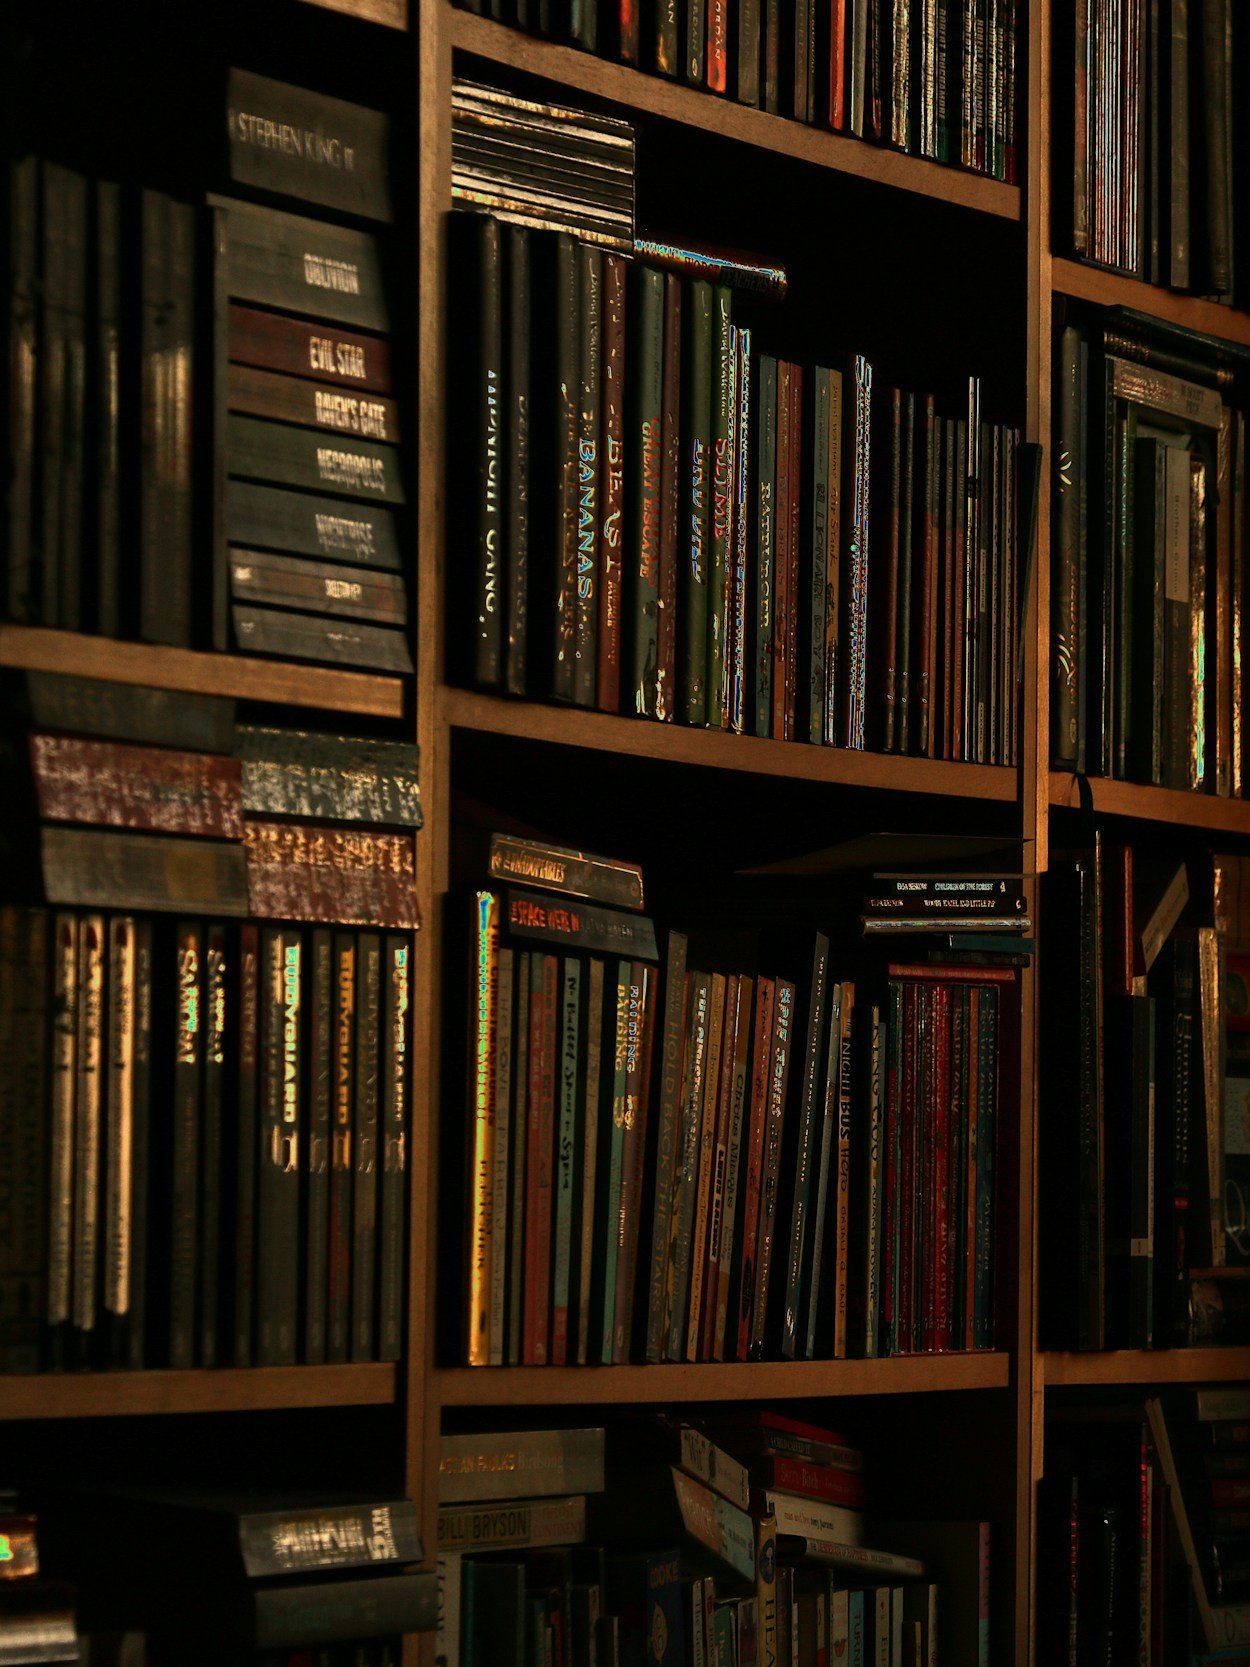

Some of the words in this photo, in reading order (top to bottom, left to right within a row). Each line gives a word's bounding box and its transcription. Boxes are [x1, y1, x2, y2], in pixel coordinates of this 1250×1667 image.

[238, 112, 303, 158] STEPHEN
[304, 130, 341, 168] KING
[309, 334, 335, 373] EVIL
[337, 341, 366, 379] STAR
[641, 421, 652, 490] GREAT
[713, 438, 728, 540] SLIME
[578, 438, 596, 599] BANANAS
[639, 497, 651, 577] ESCAPE
[760, 482, 772, 628] RATBURGER
[284, 942, 301, 1123] BODYGUARD
[338, 946, 355, 1125] BODYGUARD
[627, 985, 639, 1074] BALDING
[664, 1020, 678, 1094] HOLD
[870, 1025, 881, 1096] KING
[840, 1041, 852, 1093] NIGHT
[660, 1103, 675, 1169] BACK
[731, 1073, 745, 1138] Circus
[840, 1101, 852, 1141] BUS
[870, 1105, 881, 1162] COO
[657, 1181, 669, 1227] THE
[715, 1149, 725, 1194] LOUIS
[711, 1199, 722, 1264] SACHAR
[652, 1236, 667, 1312] STARS
[437, 1517, 465, 1541] BILL
[472, 1510, 527, 1540] BRYSON
